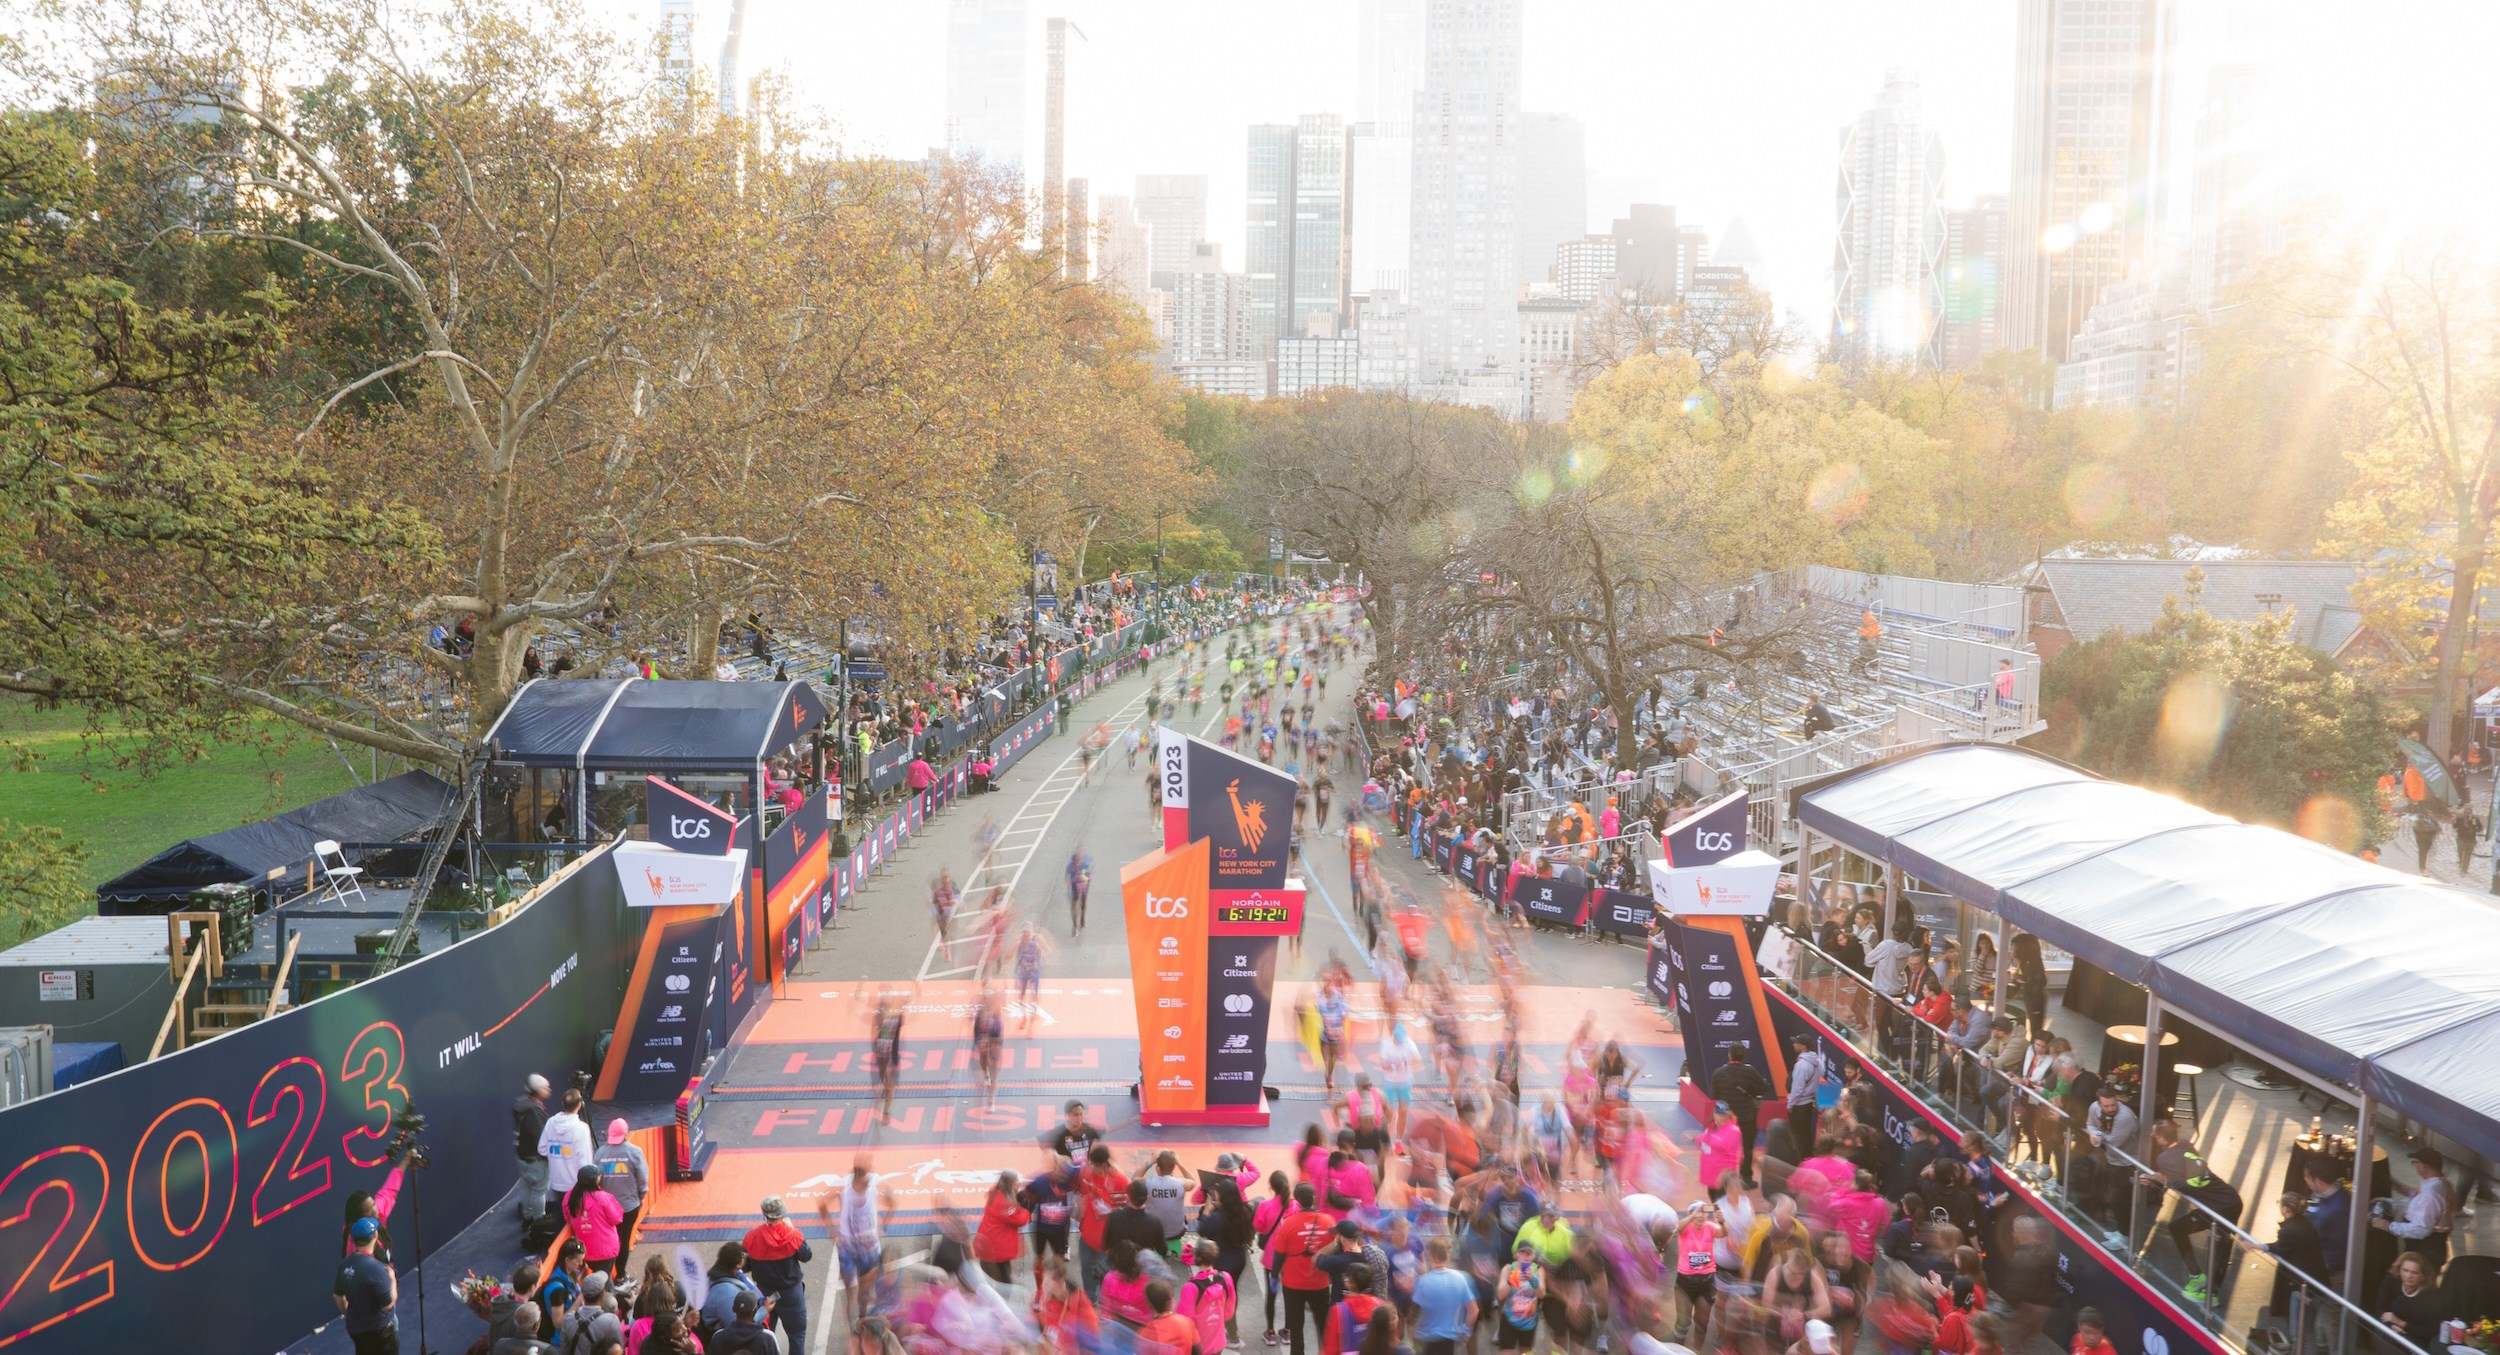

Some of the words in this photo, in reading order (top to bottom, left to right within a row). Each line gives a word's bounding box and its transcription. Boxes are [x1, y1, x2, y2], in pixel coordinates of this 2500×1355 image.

[880, 764, 888, 777] WILL
[1166, 745, 1183, 799] 2023
[671, 814, 711, 839] tcs
[1695, 827, 1732, 851] tcs
[1219, 846, 1238, 859] tcs
[1146, 891, 1189, 919] tcs
[1530, 900, 1562, 914] Citizens
[672, 956, 697, 964] Citizens
[1700, 963, 1725, 971] Citizens
[1223, 968, 1257, 977] Citizens
[439, 1047, 452, 1069] IT
[454, 1031, 482, 1060] WILL
[550, 962, 567, 989] MOVE
[566, 952, 578, 973] YOU
[1223, 1034, 1249, 1048] NB
[781, 1047, 1100, 1074] FINISH
[751, 1104, 1109, 1137] FINISH
[1883, 1104, 1904, 1144] tcs
[0, 1021, 410, 1348] 2023
[786, 1189, 827, 1199] NEW
[893, 1187, 945, 1196] ROAD
[1152, 1188, 1177, 1199] CREW
